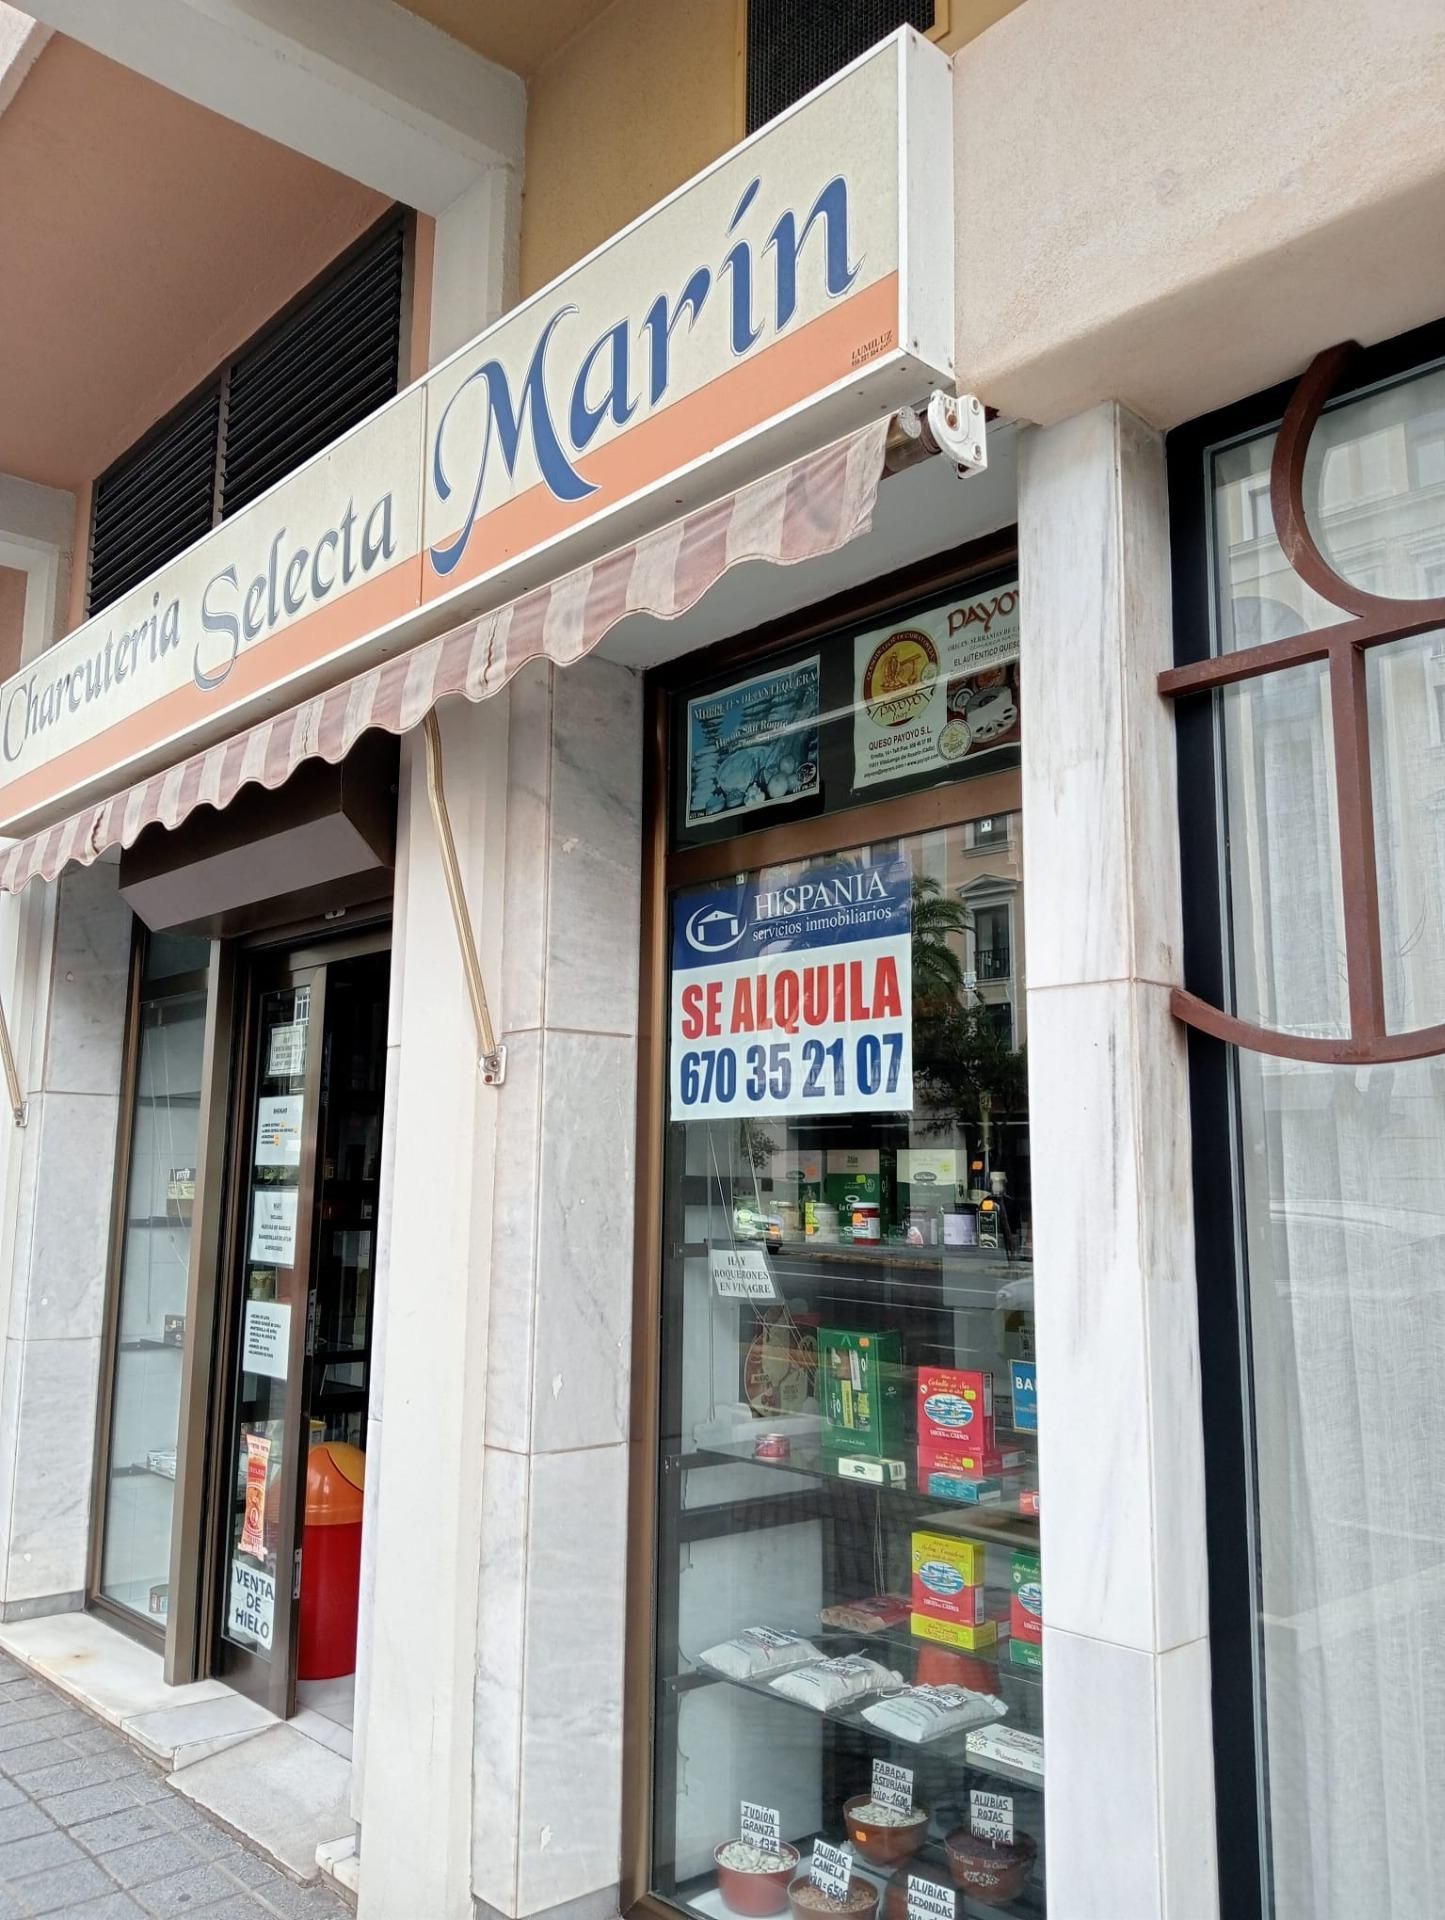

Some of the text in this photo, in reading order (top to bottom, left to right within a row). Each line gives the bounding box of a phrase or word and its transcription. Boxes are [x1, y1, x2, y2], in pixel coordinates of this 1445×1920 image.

[430, 174, 866, 576] Marín
[193, 491, 398, 693] Selecta
[868, 737, 893, 751] QUESO
[893, 729, 920, 746] PAYOYO
[753, 871, 889, 921] HISPANIA
[753, 906, 892, 942] servicios inmobiliarios
[681, 956, 903, 1040] SE ALQUILA
[680, 1032, 903, 1106] 670 35 21 07
[727, 1256, 746, 1266] HAY
[714, 1268, 769, 1280] BOQUERONES
[733, 1282, 771, 1294] VINAGRE
[1015, 1376, 1037, 1392] BA
[235, 1566, 274, 1600] VENTA
[246, 1594, 262, 1614] DE
[235, 1607, 270, 1640] HIELO
[875, 1762, 906, 1781] FABADA
[873, 1774, 911, 1795] ASTURIANA
[975, 1793, 1009, 1810] ALUBIAS
[977, 1808, 1004, 1823] ROJAS
[743, 1820, 775, 1836] GRANJA
[815, 1843, 849, 1868] ALUBIAS
[813, 1857, 845, 1881] CANELA
[911, 1878, 949, 1901] ALUBIAS
[908, 1893, 953, 1919] REDONDAS
